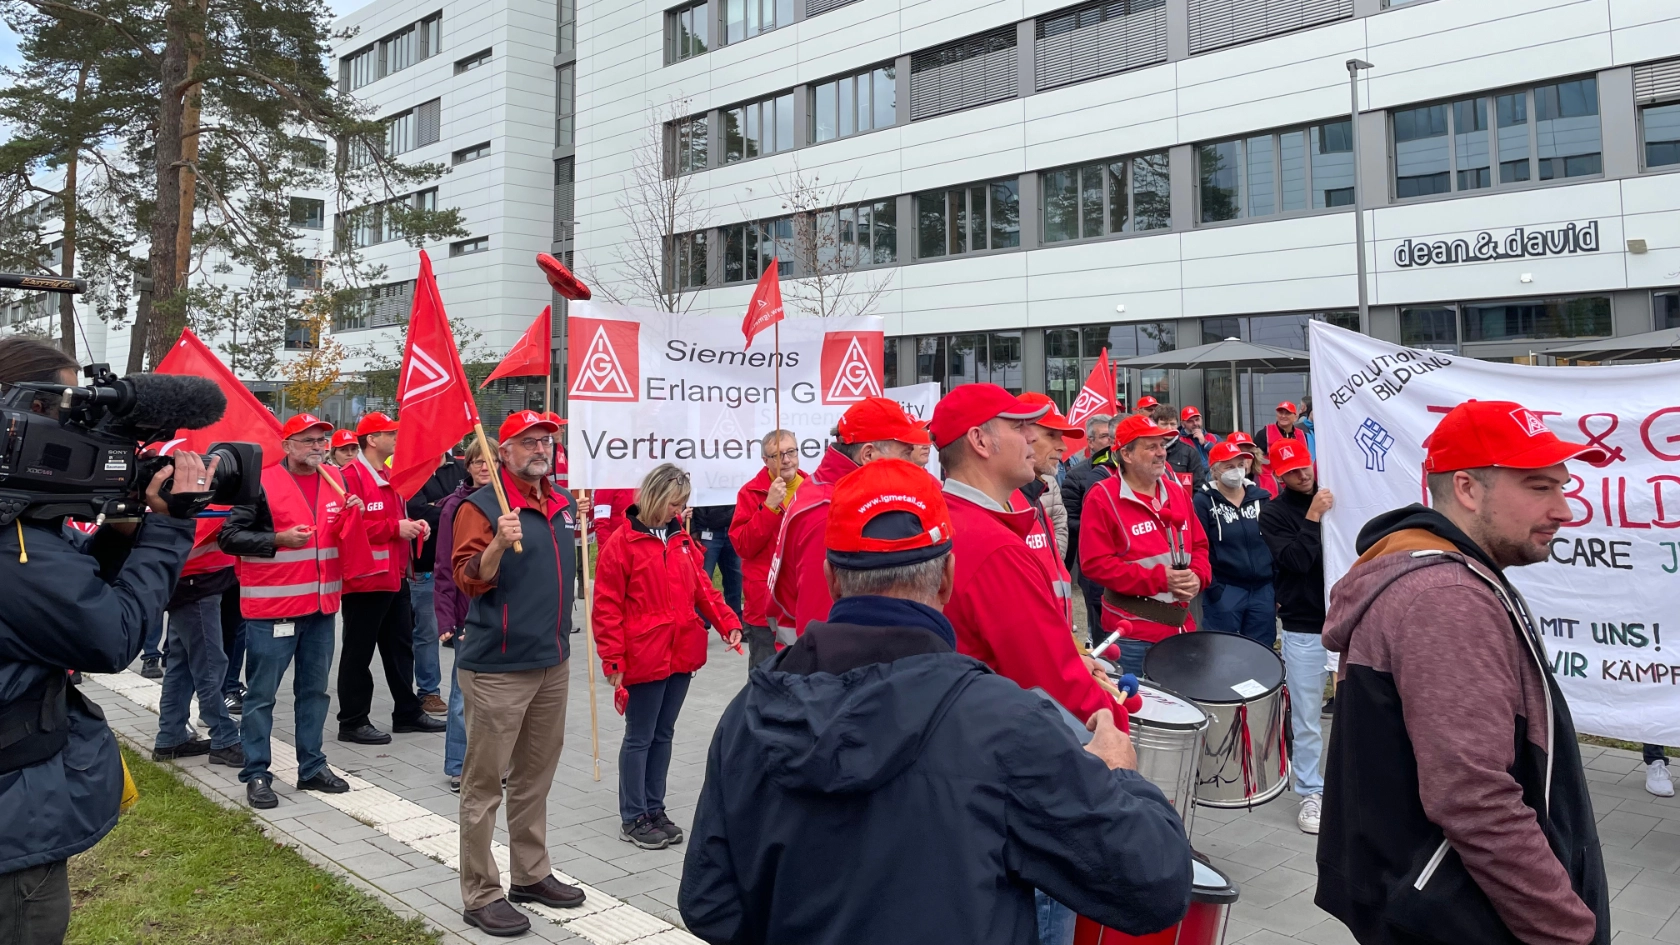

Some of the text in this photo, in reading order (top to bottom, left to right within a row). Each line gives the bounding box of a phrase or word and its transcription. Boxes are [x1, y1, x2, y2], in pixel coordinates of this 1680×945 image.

[665, 339, 800, 368] Siemens
[647, 377, 816, 409] Erlangen G
[1372, 355, 1453, 402] BILDUNG
[1540, 616, 1580, 639] MIT
